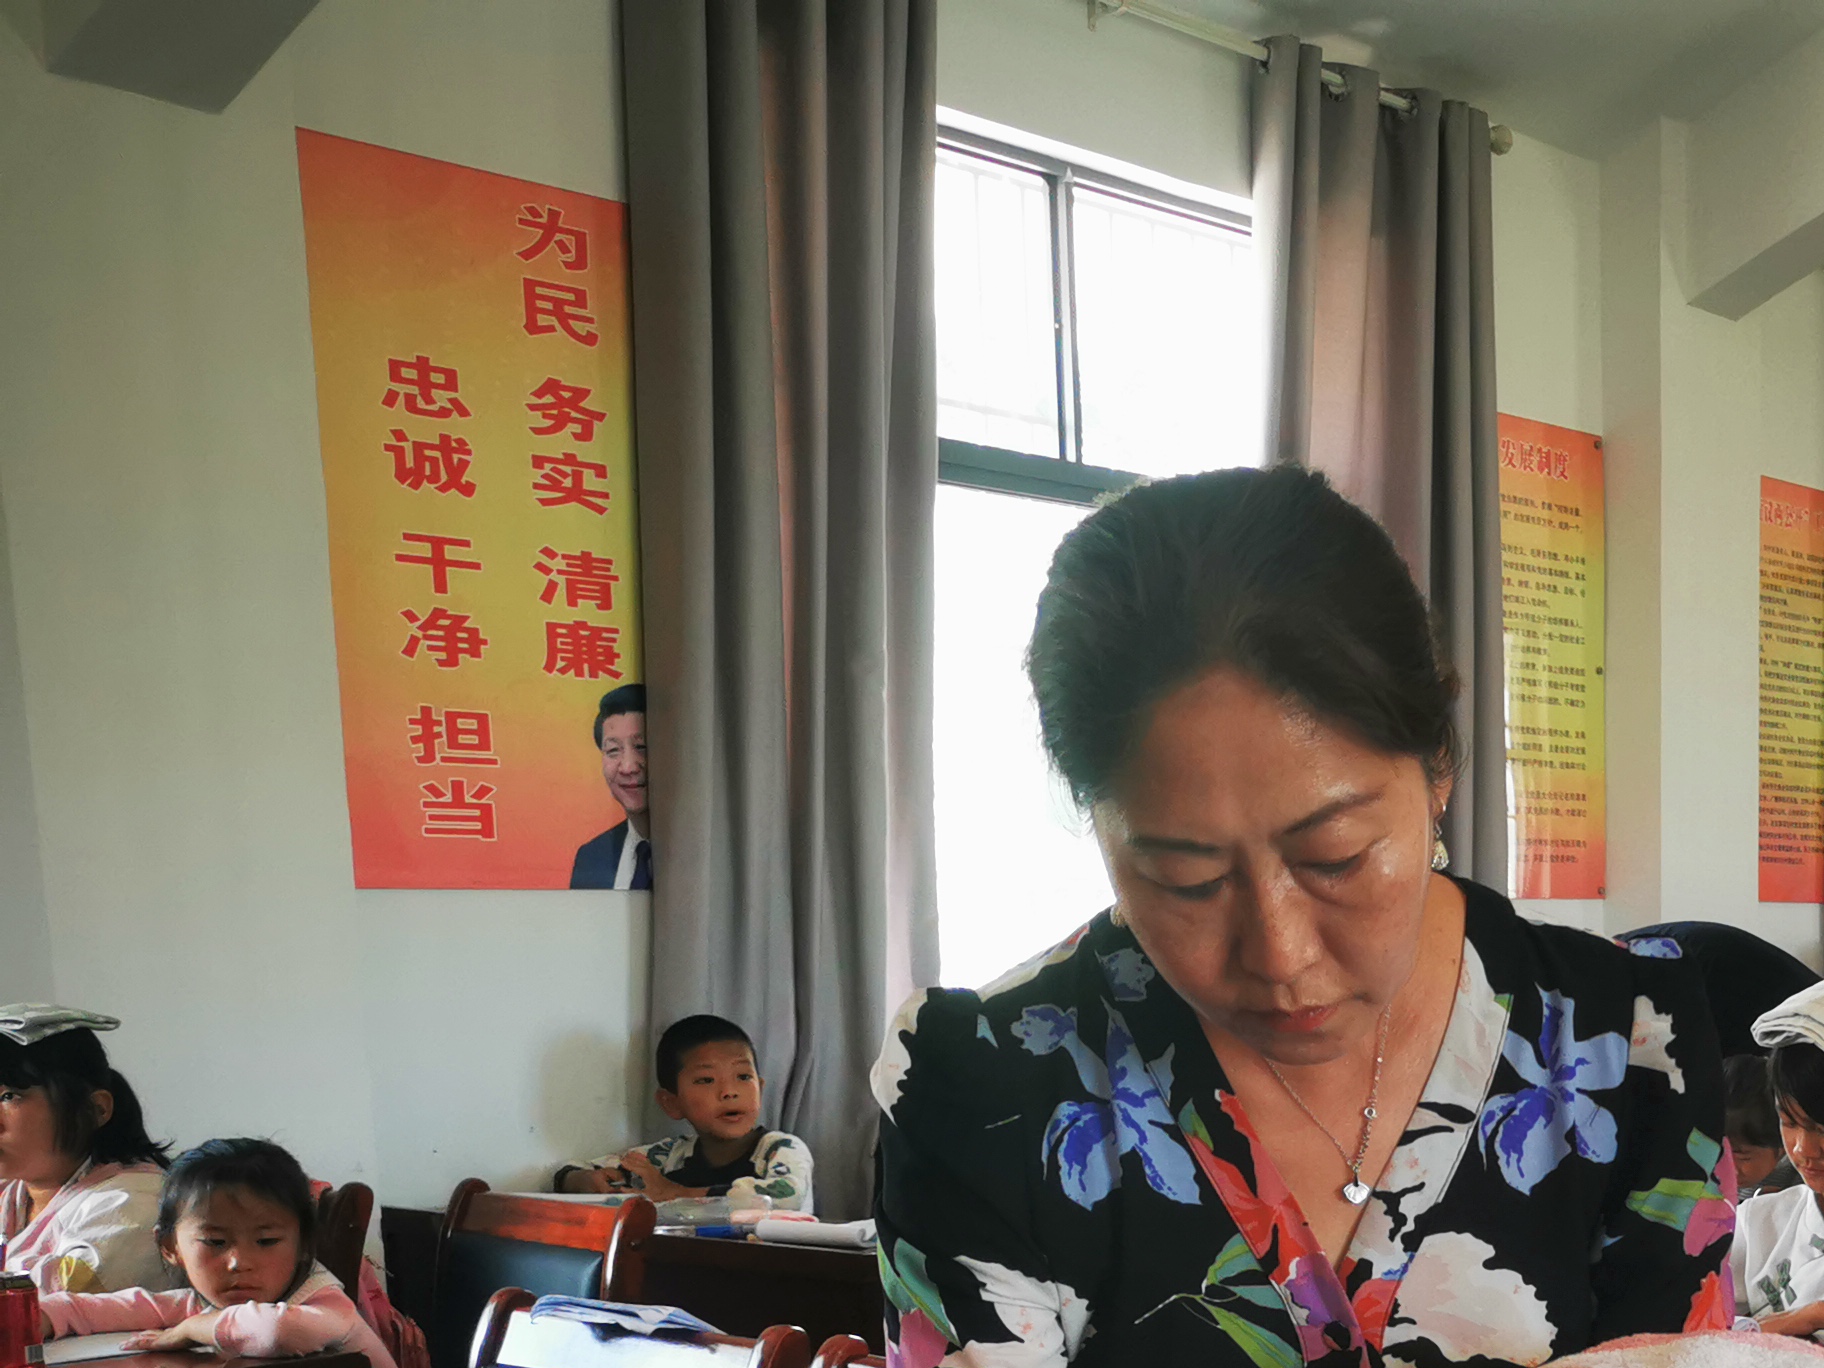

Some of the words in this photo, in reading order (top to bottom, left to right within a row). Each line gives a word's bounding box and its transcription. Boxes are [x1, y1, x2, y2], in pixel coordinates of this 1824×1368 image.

[514, 202, 599, 347] 为民
[380, 354, 478, 499] 忠诚
[525, 377, 611, 516] 务实
[393, 530, 488, 669] 干净
[532, 544, 623, 680] 清廉
[407, 704, 499, 841] 担当
